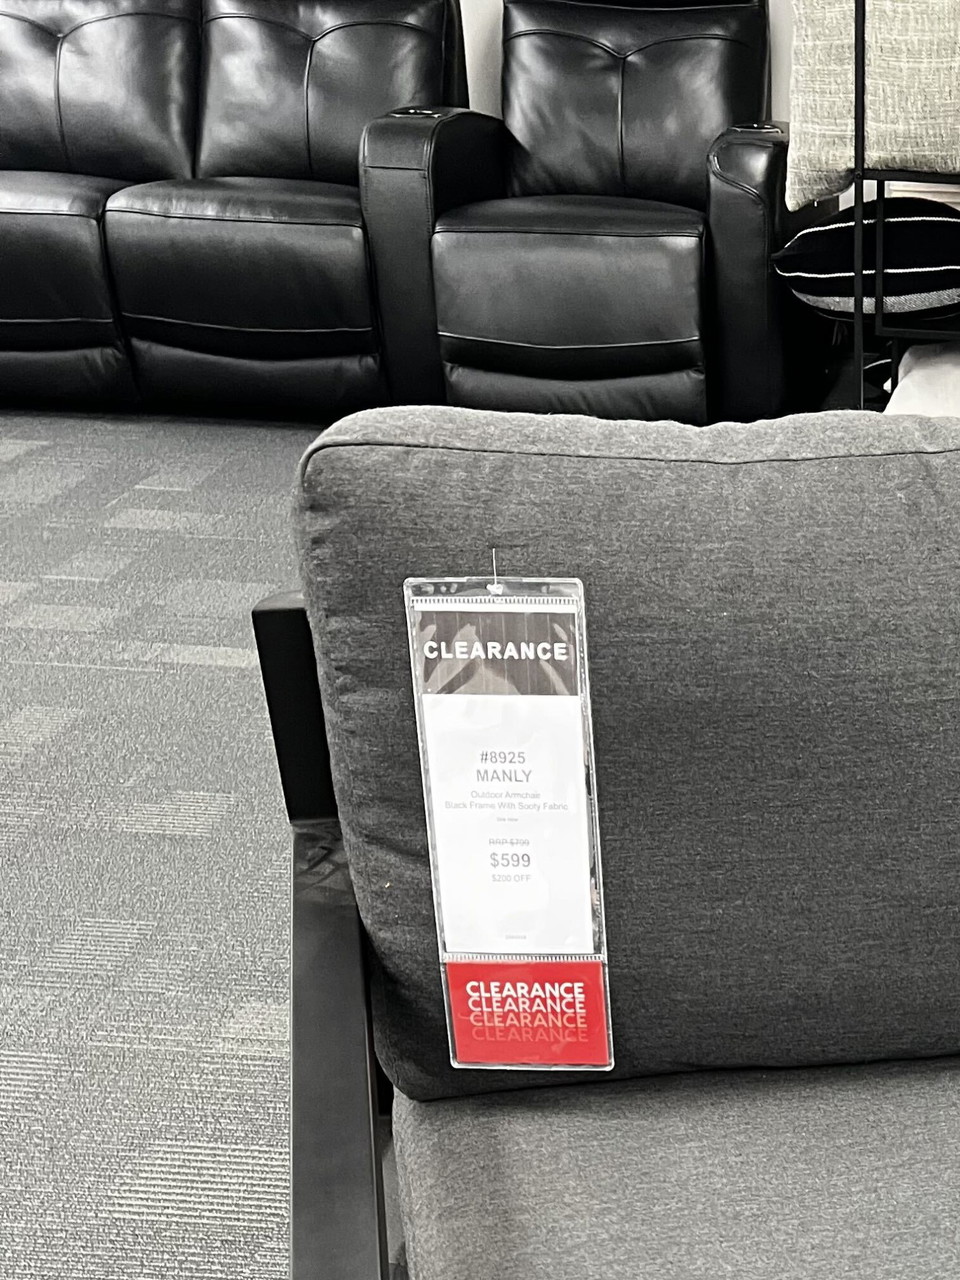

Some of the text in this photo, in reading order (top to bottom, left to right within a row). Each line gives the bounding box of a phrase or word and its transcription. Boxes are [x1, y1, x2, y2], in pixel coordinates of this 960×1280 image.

[423, 640, 569, 661] CLEARANCE
[480, 751, 526, 764] #8925
[476, 769, 532, 783] MANLY
[470, 790, 541, 799] Outdoor Armchair
[444, 801, 467, 809] Black
[469, 801, 496, 809] Frame
[518, 802, 541, 811] Sooty
[543, 802, 569, 810] Fabric
[489, 852, 531, 868] $599
[491, 874, 532, 882] $200 OFF
[466, 981, 586, 998] CLEARANCE
[468, 997, 587, 1013] CLEARANCE
[470, 1012, 588, 1028] CLEARANCE
[472, 1027, 589, 1042] CLEARANCE
